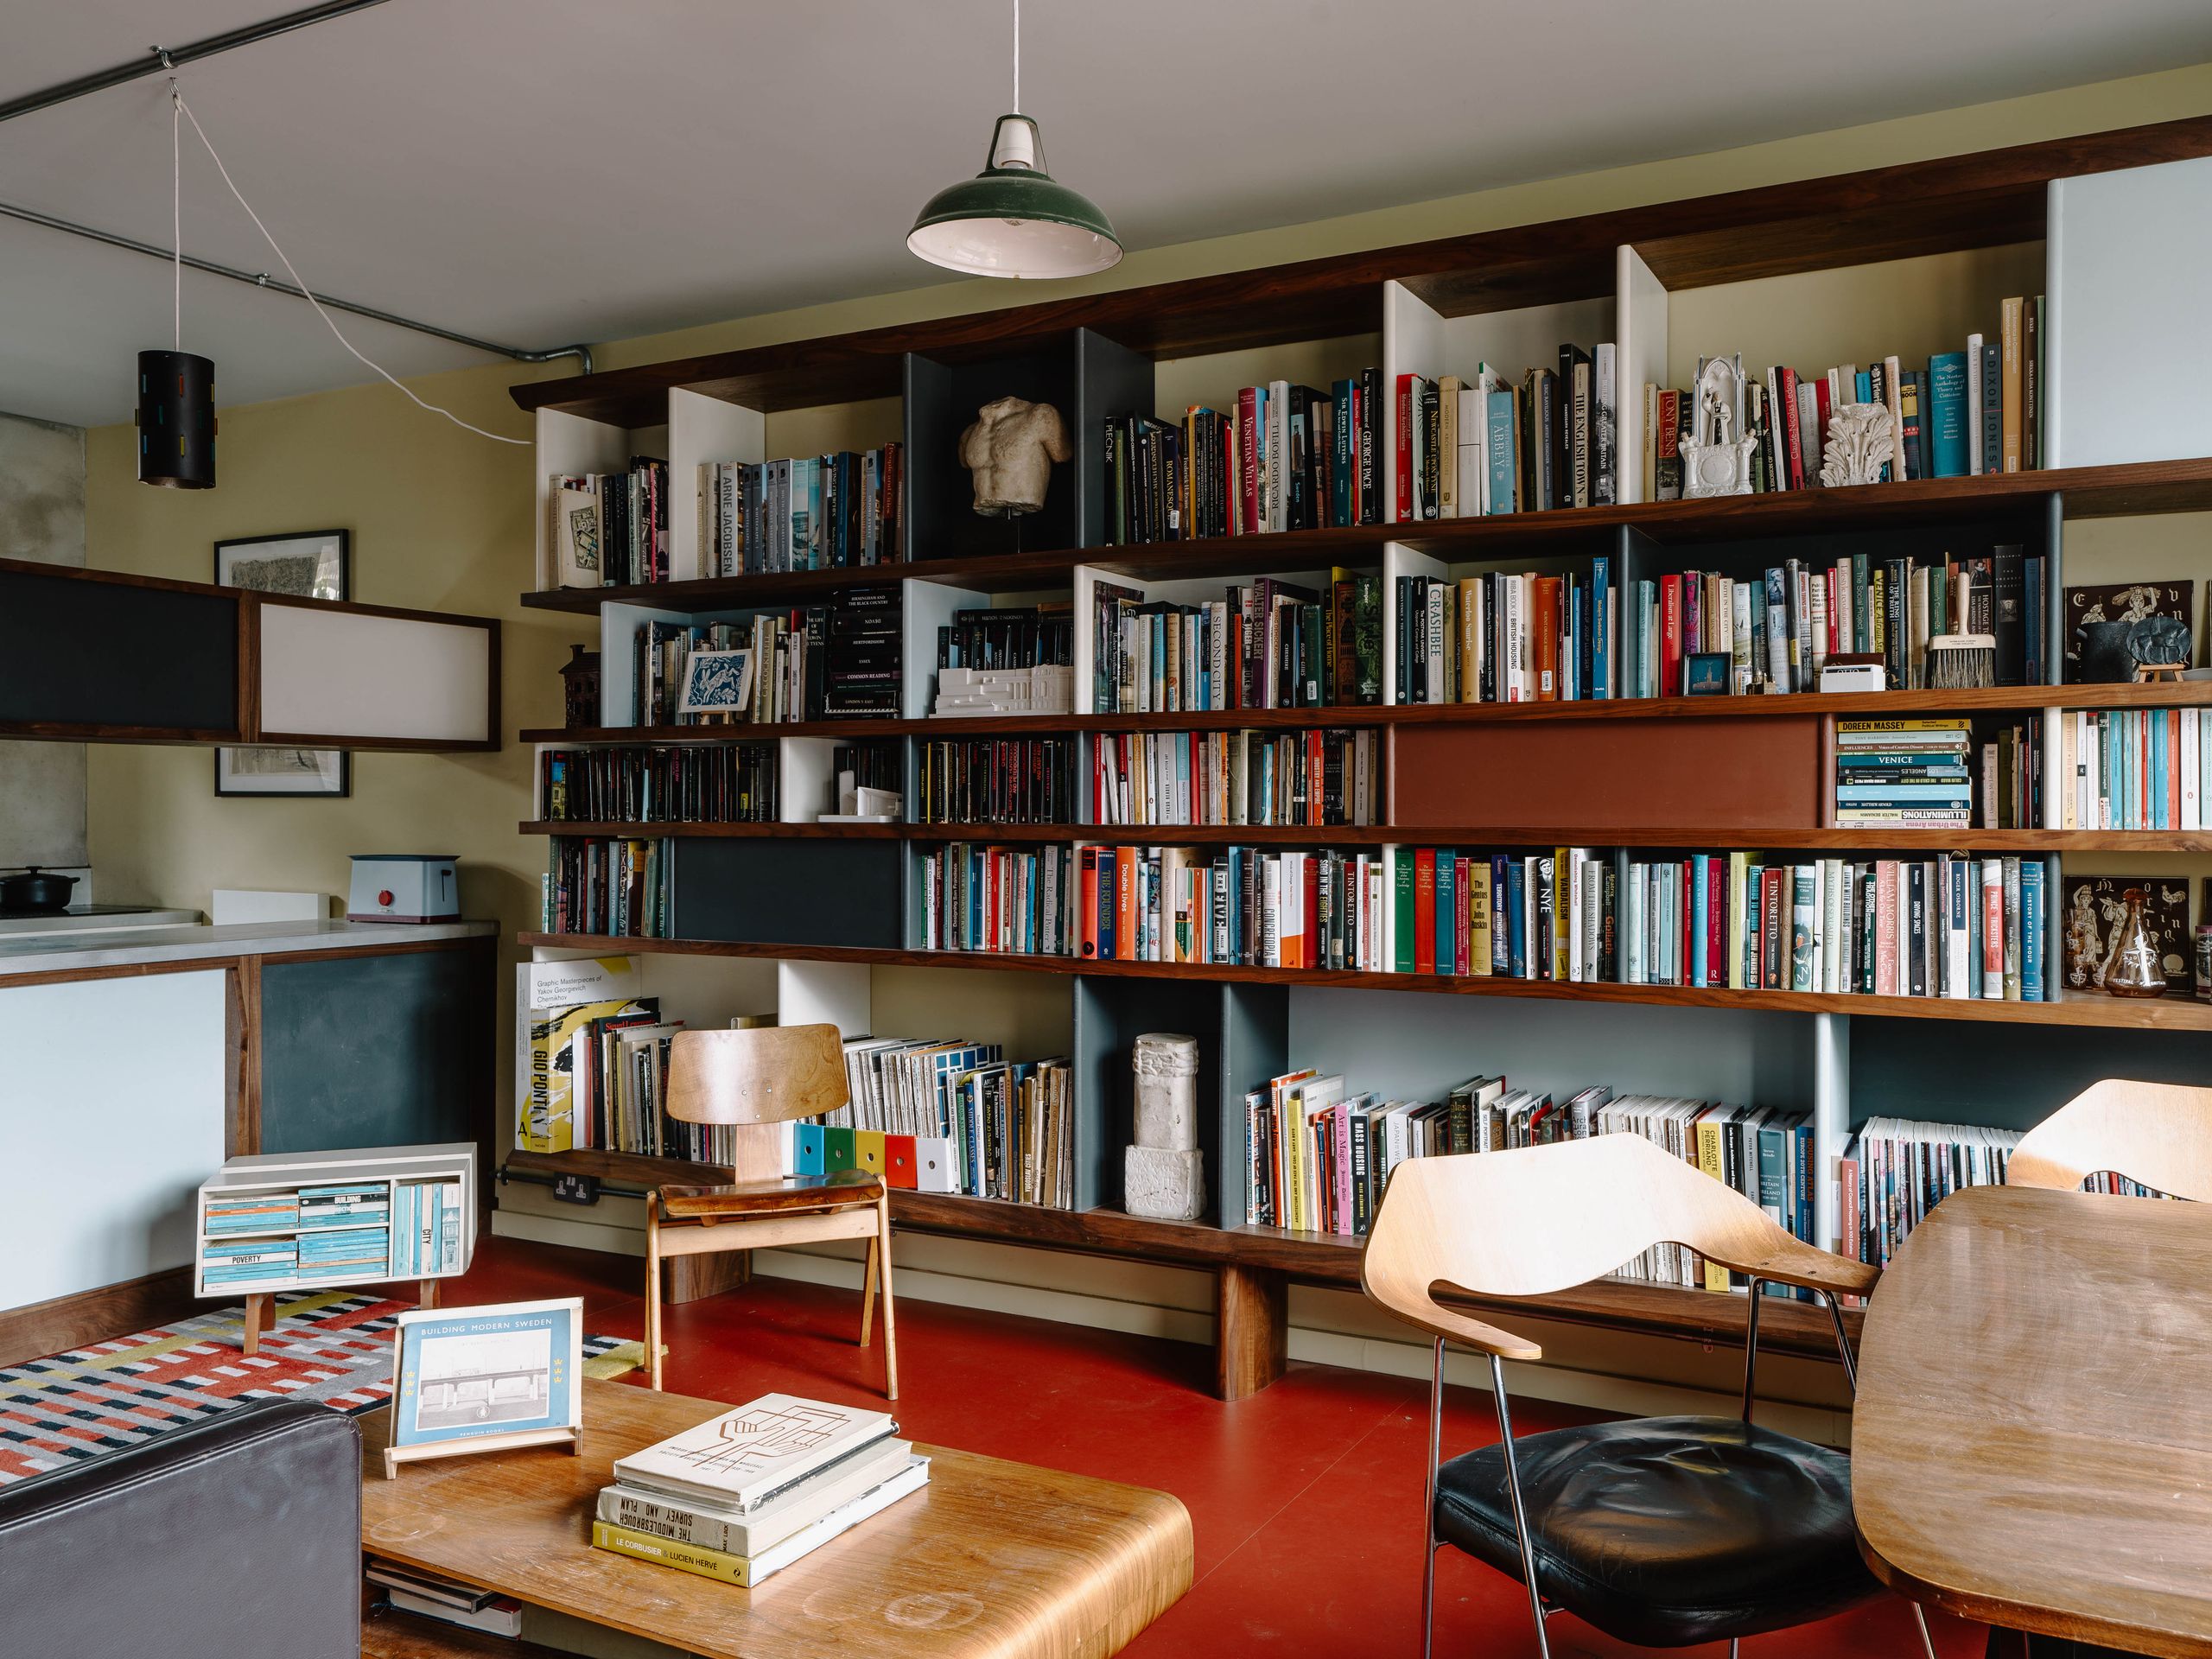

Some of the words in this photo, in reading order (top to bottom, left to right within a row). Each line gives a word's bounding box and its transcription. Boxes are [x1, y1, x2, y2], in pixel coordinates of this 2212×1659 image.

[1576, 393, 1585, 414] THE
[1666, 394, 1675, 423] TONY
[1363, 431, 1371, 466] GEORGE
[1494, 425, 1504, 467] ABBEY
[1575, 416, 1585, 460] ENGLISH
[1666, 428, 1675, 455] BENN
[1988, 416, 1997, 461] JONES
[723, 477, 732, 508] ARNE
[723, 512, 733, 572] JACOBSEN
[1255, 582, 1264, 619] WALTER
[1254, 622, 1263, 660] SICKERT
[1102, 870, 1110, 888] THE
[1319, 860, 1328, 874] SOHO
[1103, 890, 1111, 930] FOUNDER
[1215, 892, 1226, 926] FIVE
[1541, 888, 1551, 913] NYE
[1264, 909, 1274, 956] CONCRETOPIA
[1605, 916, 1614, 954] Goliath
[2027, 921, 2033, 930] OF
[533, 1051, 547, 1071] GIO
[534, 1074, 547, 1109] PONTI
[334, 1196, 361, 1205] BUILDING
[232, 1255, 261, 1264] POVERTY
[422, 1325, 465, 1335] BUILDING
[472, 1322, 509, 1331] MODERN
[515, 1319, 552, 1327] SWEDEN
[620, 1497, 637, 1512] PLAN
[645, 1503, 658, 1515] AND
[665, 1511, 692, 1526] SURVEY
[620, 1514, 675, 1539] MIDDLESBROUGH
[679, 1530, 691, 1542] THE
[616, 1538, 624, 1548] LE
[625, 1541, 662, 1556] CORBUSIER
[670, 1552, 694, 1565] LUCIEN
[696, 1554, 717, 1570] HERVÉ
